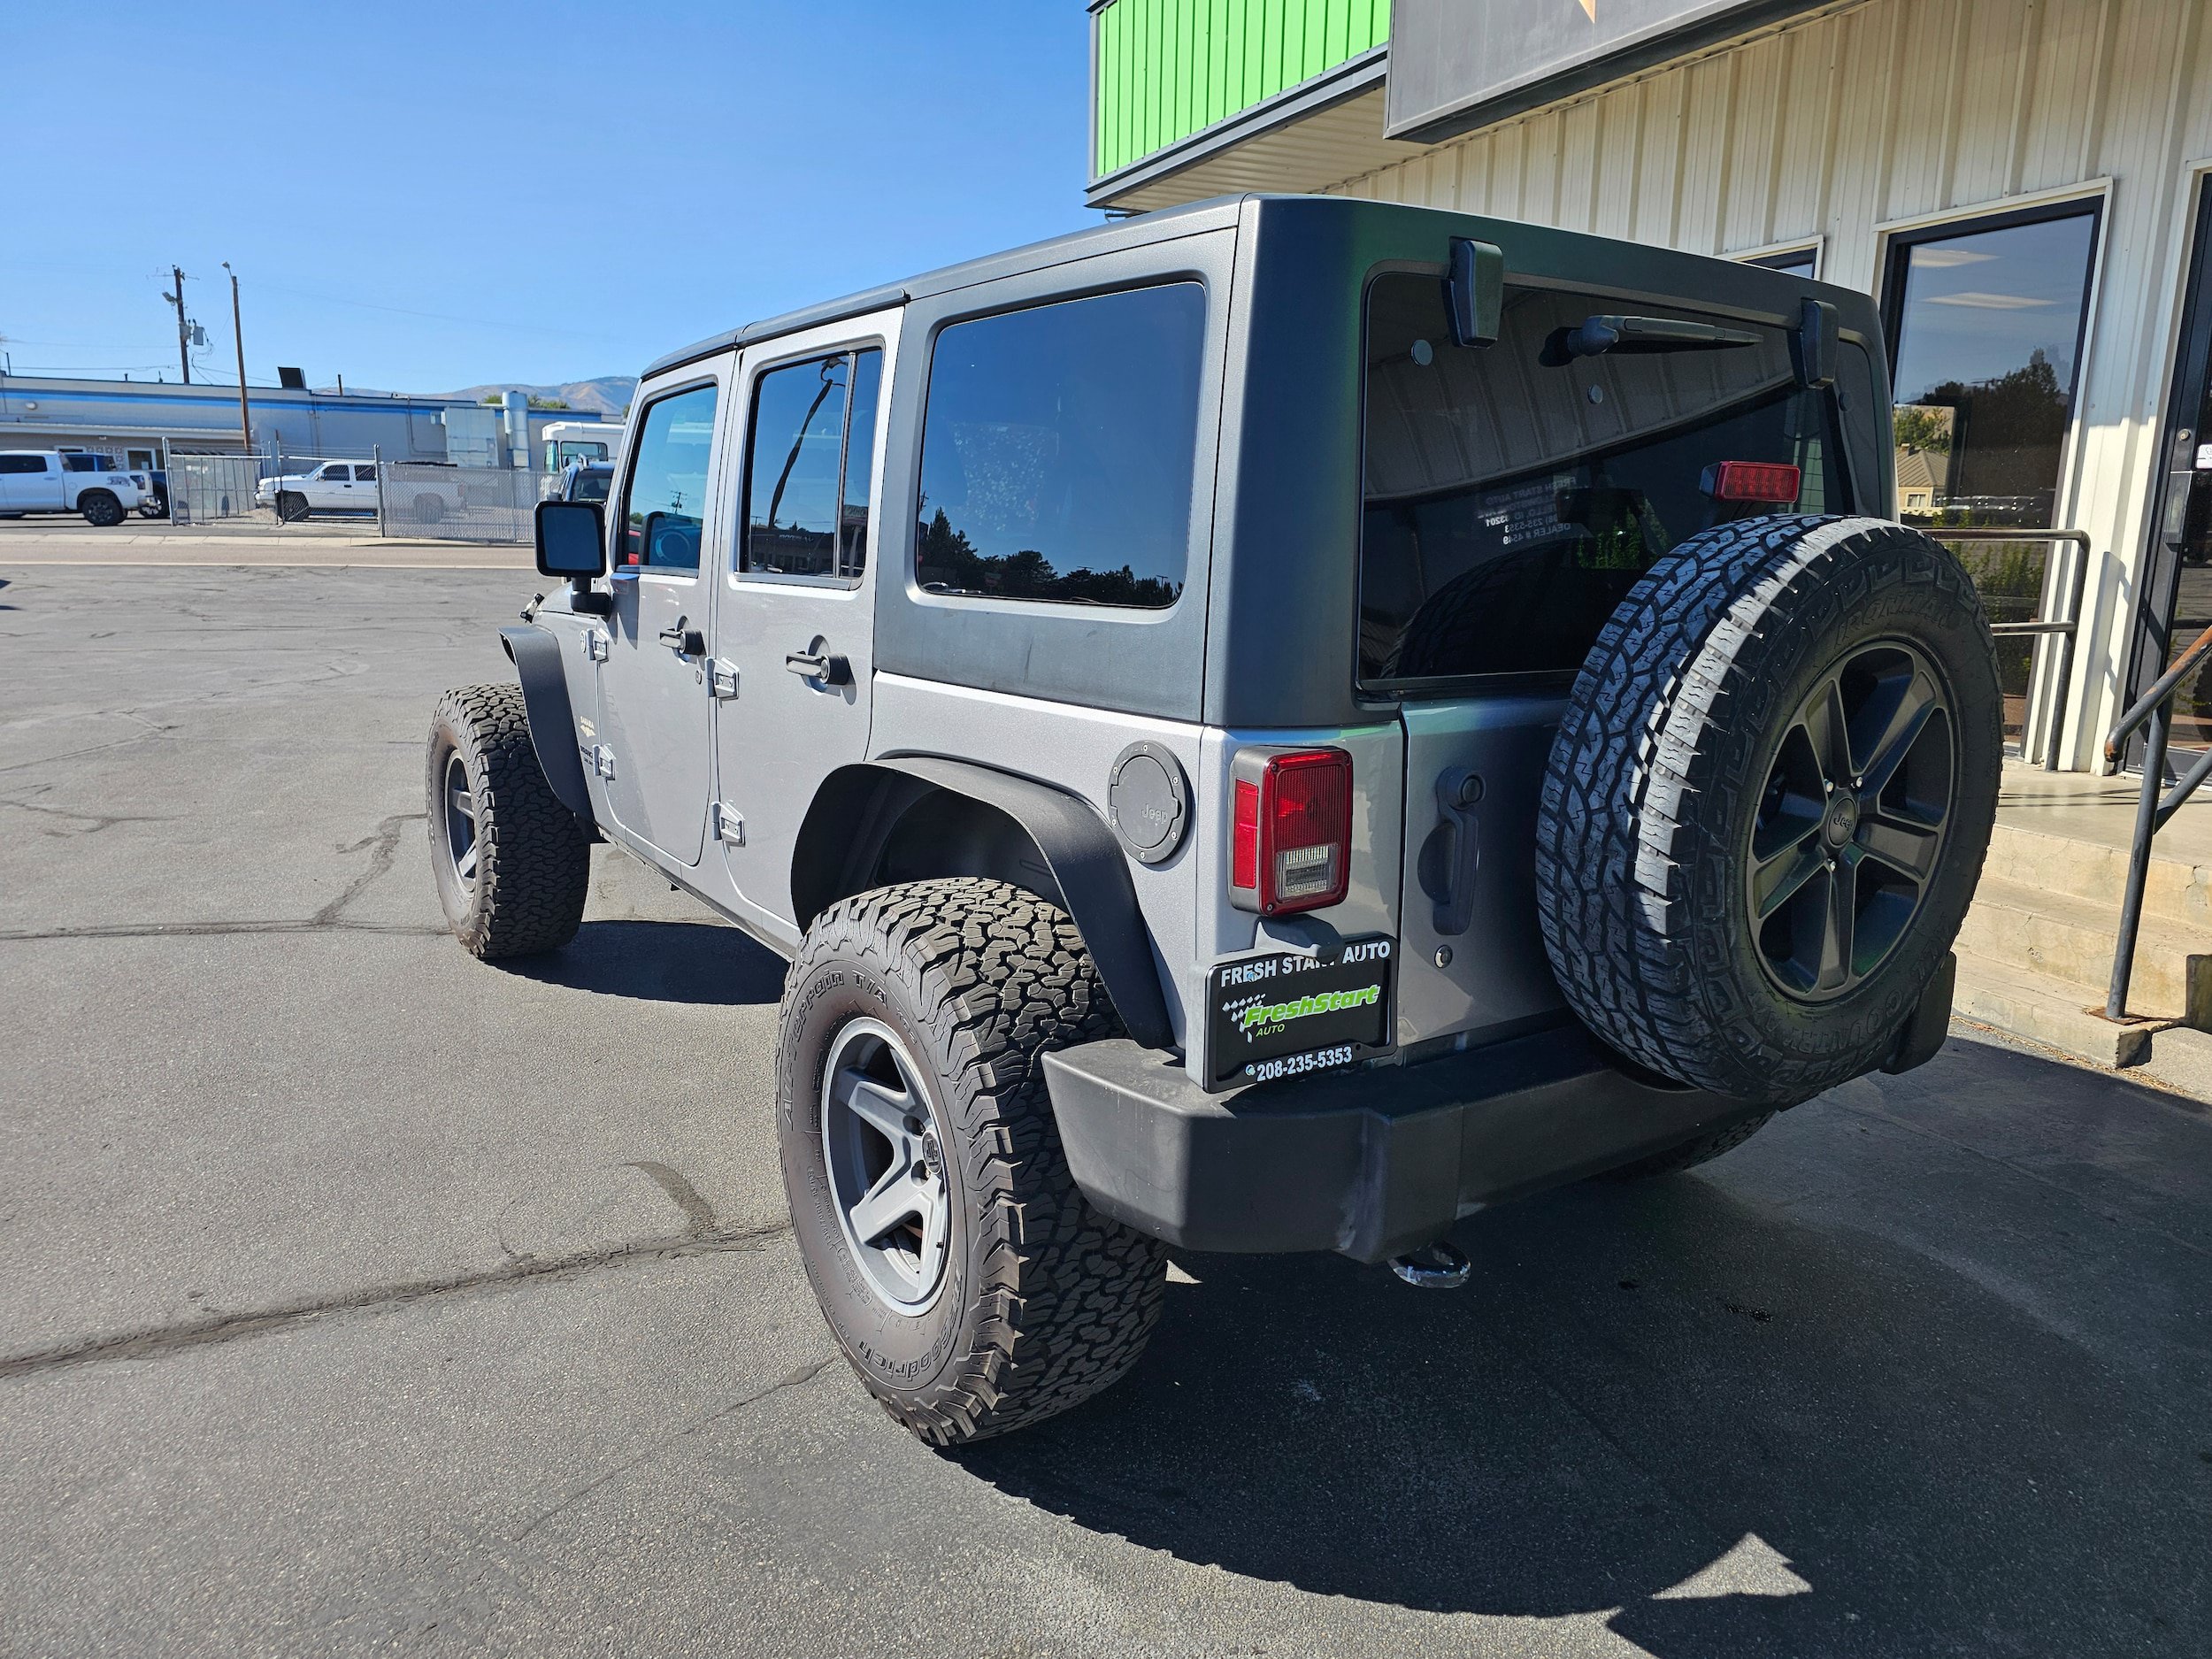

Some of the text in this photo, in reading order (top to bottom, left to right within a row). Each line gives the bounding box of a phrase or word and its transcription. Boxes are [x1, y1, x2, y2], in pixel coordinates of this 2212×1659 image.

[1141, 803, 1168, 824] Jeep
[1220, 941, 1392, 987] FRESH STA AUTO
[1244, 984, 1381, 1028] FreshStart
[1255, 1024, 1286, 1038] AUTO
[1256, 1046, 1354, 1082] 208-235-5353
